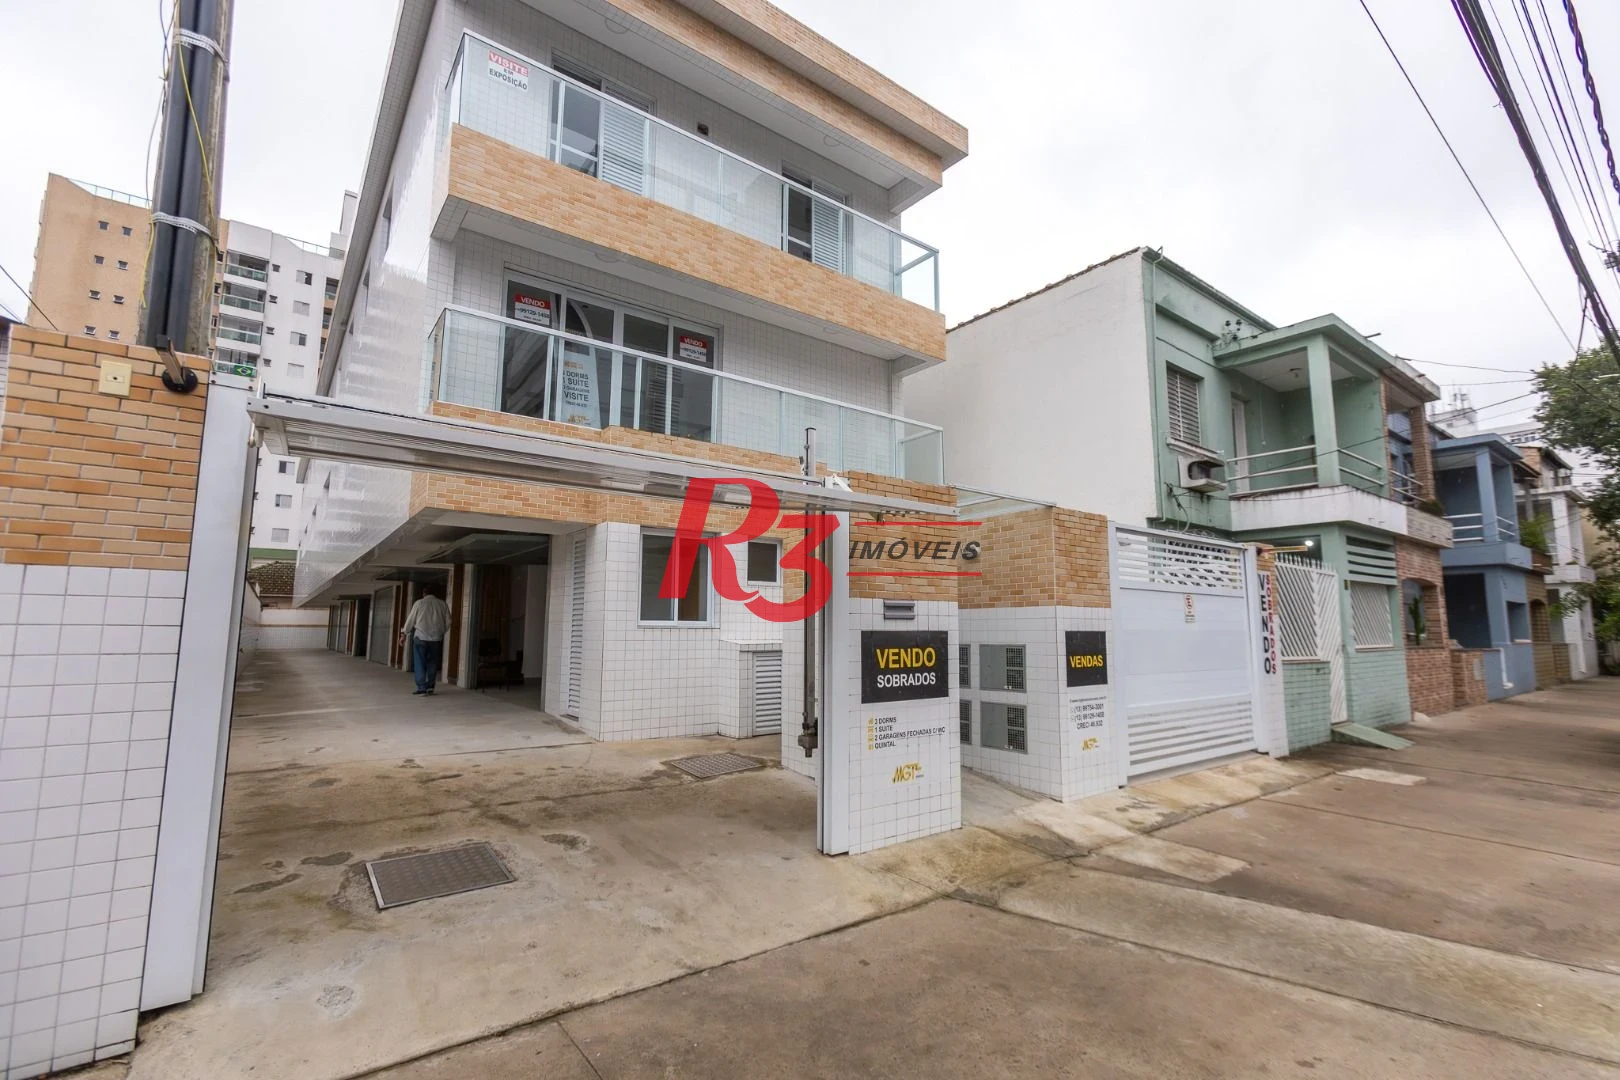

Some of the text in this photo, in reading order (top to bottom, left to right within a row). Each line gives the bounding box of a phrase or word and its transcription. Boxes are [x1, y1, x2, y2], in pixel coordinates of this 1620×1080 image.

[489, 52, 528, 76] VISITE
[489, 68, 528, 90] EXPOSIÇÃO
[520, 296, 545, 308] VENDO
[567, 378, 589, 388] SUITE
[563, 391, 589, 402] VISITE
[876, 647, 936, 669] VENDO
[1069, 655, 1104, 668] VENDAS
[877, 672, 936, 688] SOBRADOS
[878, 716, 897, 725] DORMS
[878, 725, 893, 733] SUITE
[878, 731, 906, 741] GARAGENS
[907, 728, 932, 737] FECHADAS
[874, 741, 897, 750] QUINTAL
